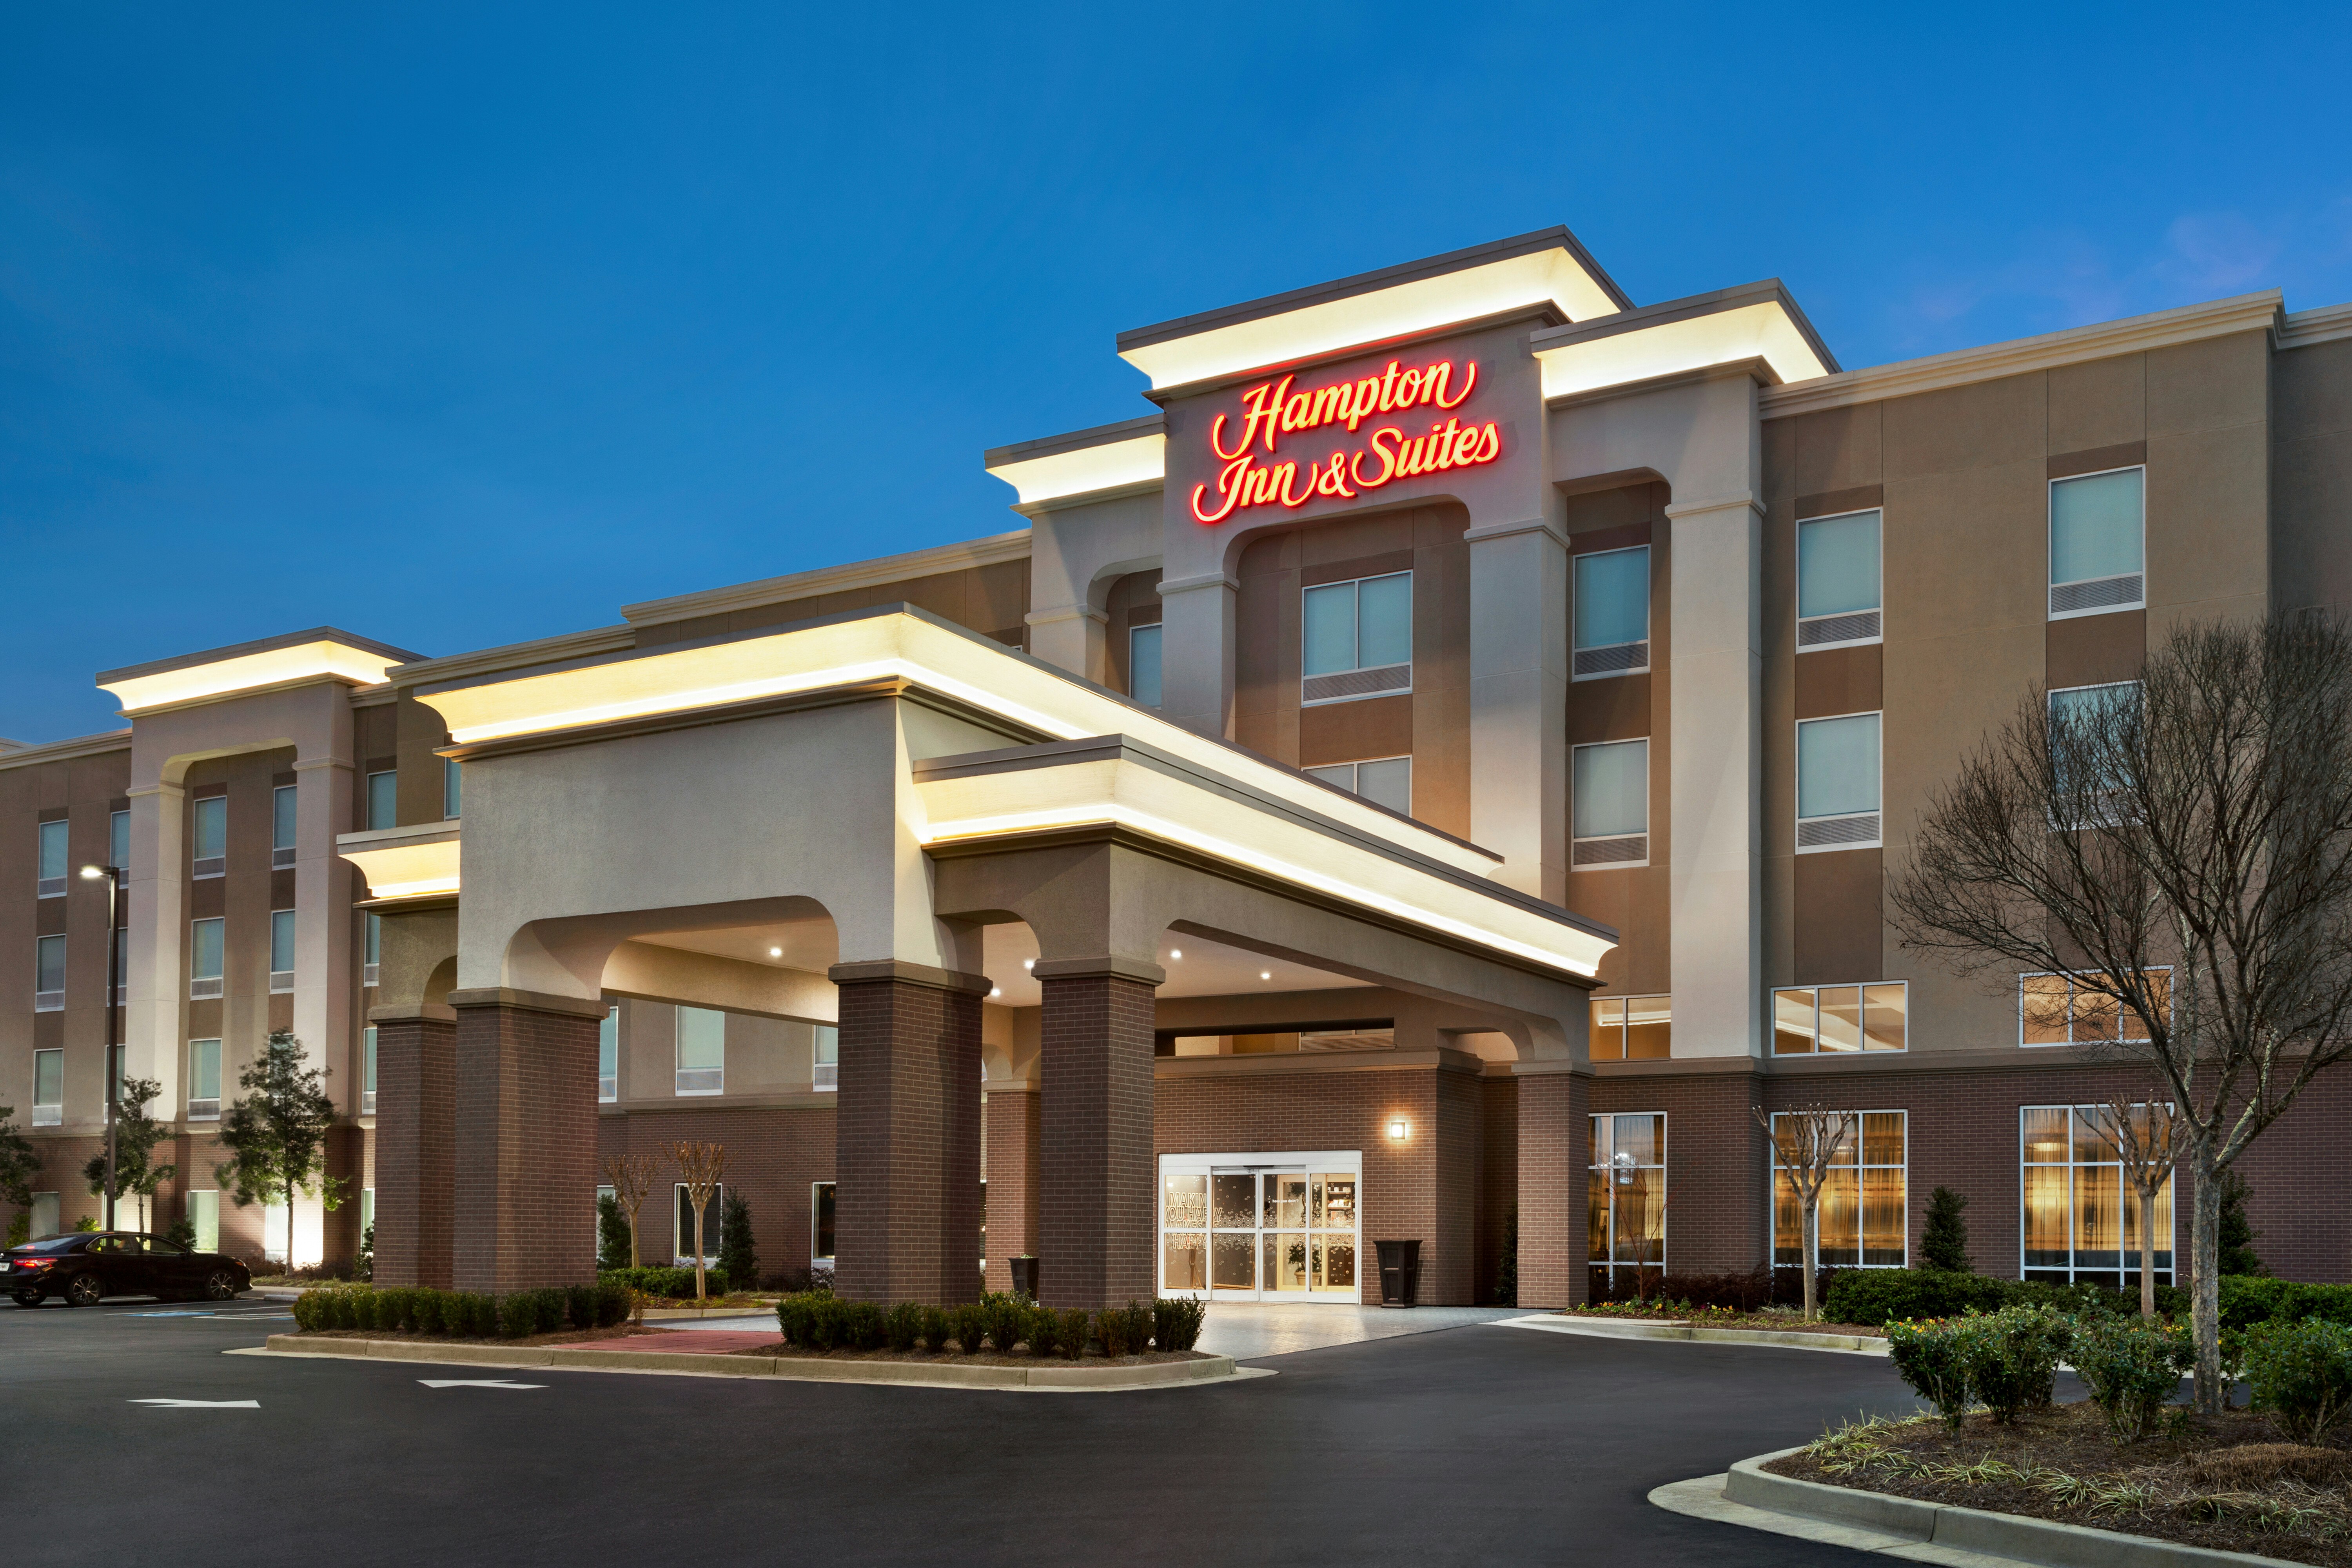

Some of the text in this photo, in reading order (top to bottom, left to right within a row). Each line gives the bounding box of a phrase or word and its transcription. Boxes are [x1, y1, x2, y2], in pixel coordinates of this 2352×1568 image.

[1212, 360, 1477, 460] Hampton
[1192, 417, 1501, 523] Inn & Suites
[1169, 1192, 1207, 1208] MAKIN
[1187, 1207, 1223, 1222] HAPY
